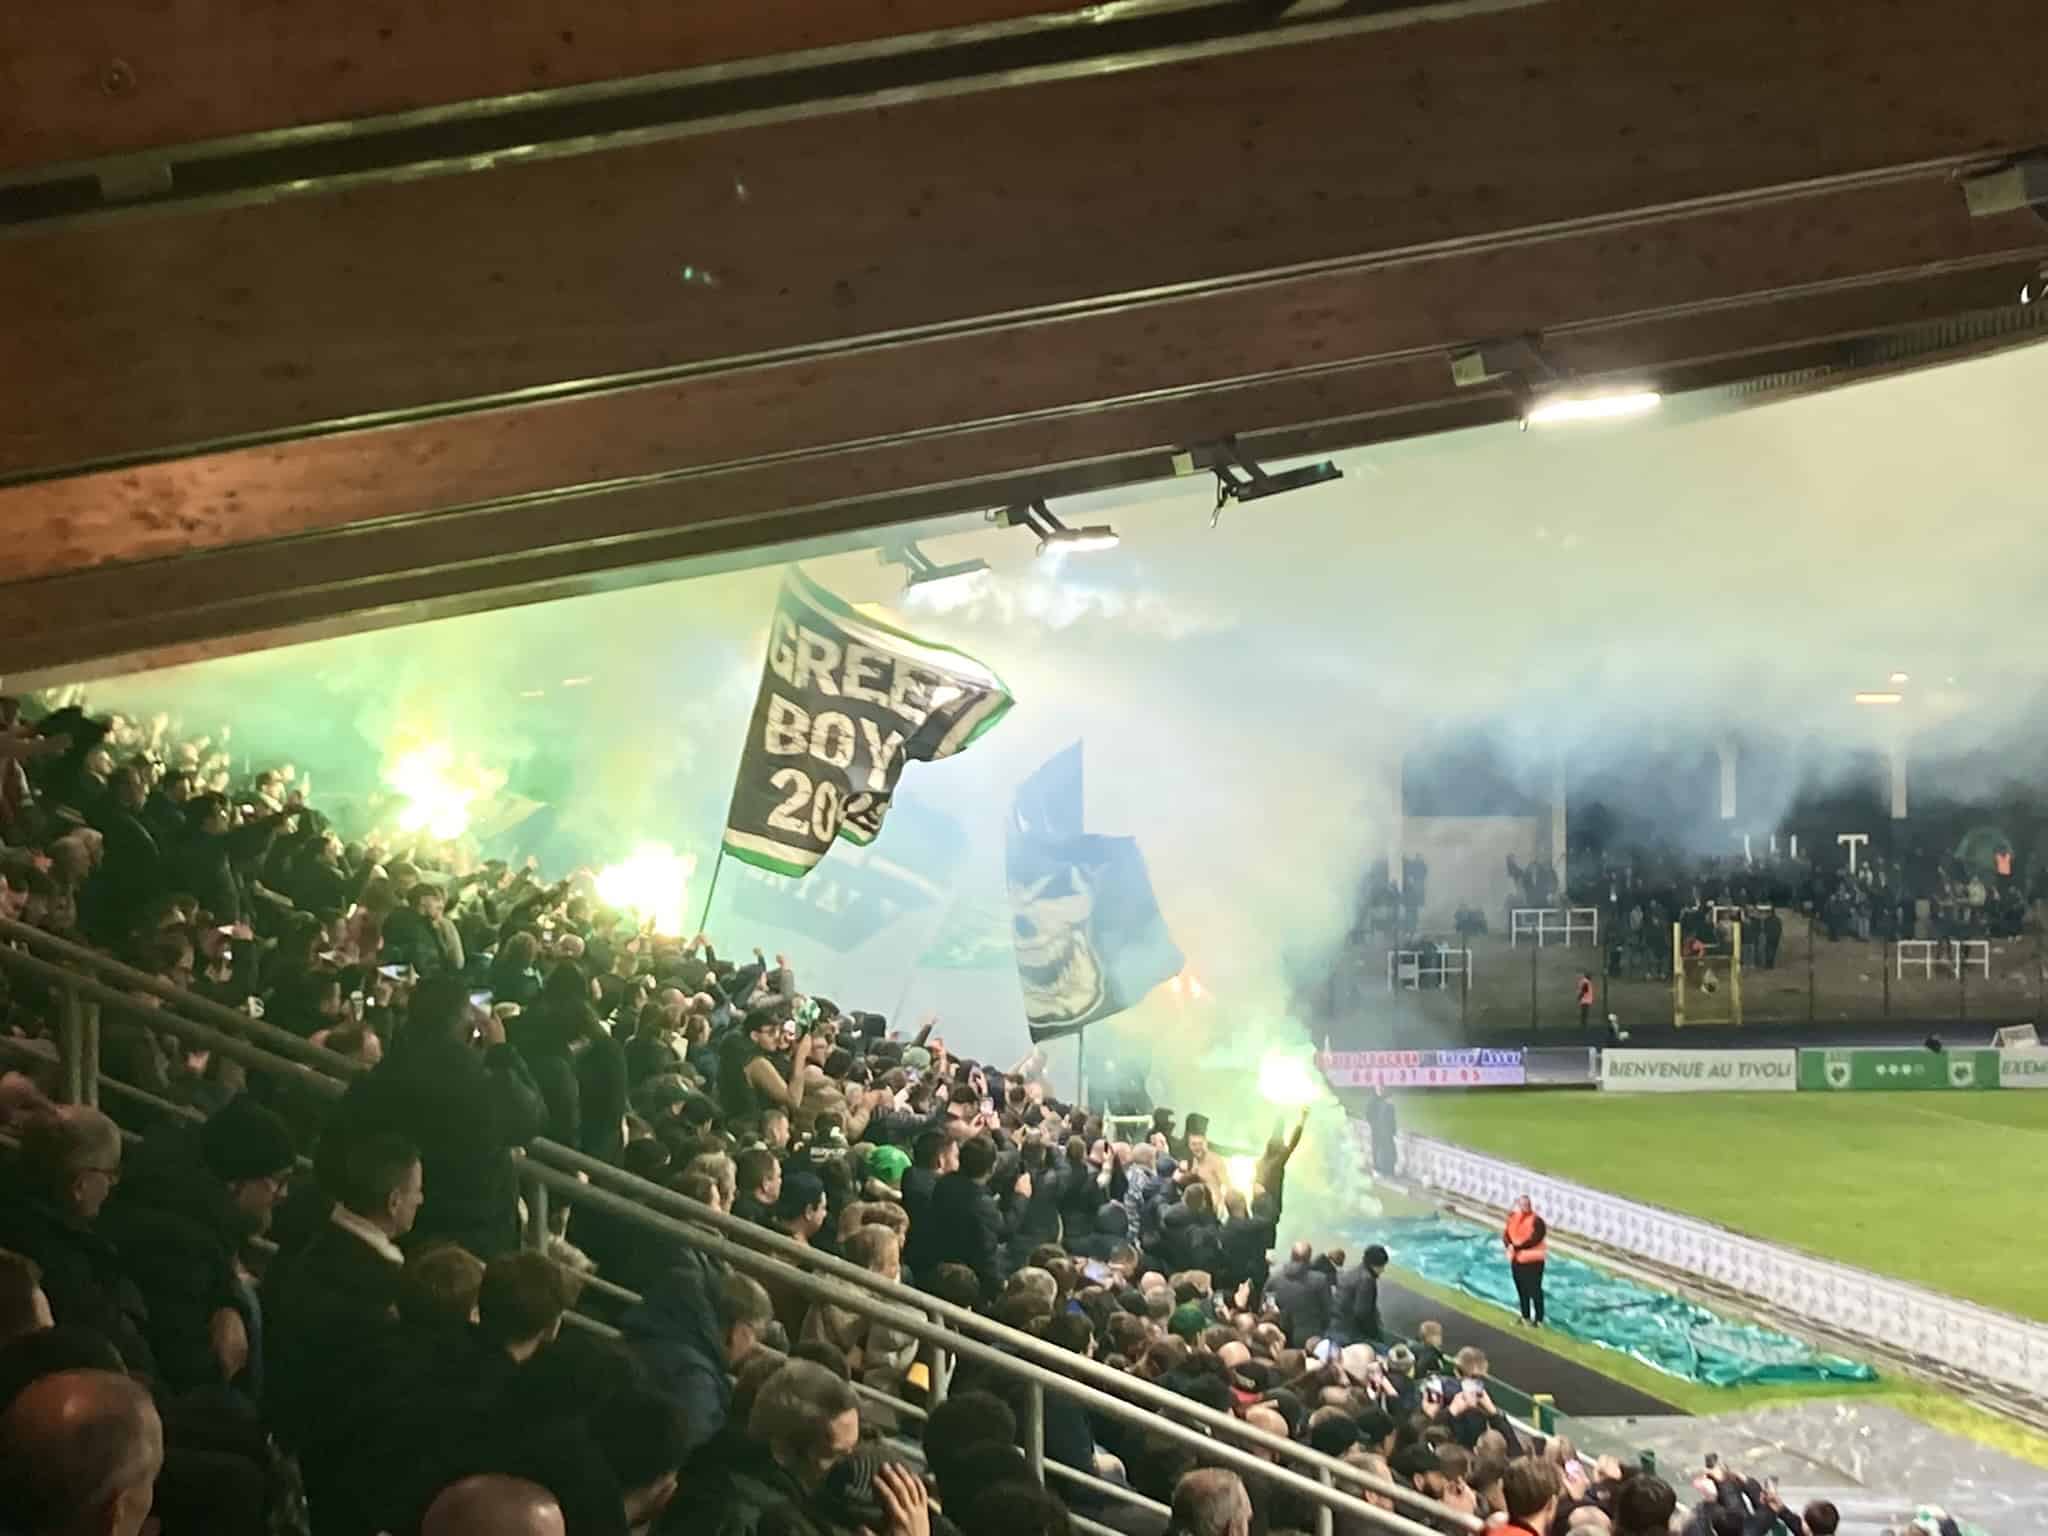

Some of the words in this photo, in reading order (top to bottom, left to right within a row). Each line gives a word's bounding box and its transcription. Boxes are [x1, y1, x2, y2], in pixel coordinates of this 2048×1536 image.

[765, 693, 905, 791] BOY
[1609, 1060, 1704, 1079] BIENVENUE
[1707, 1061, 1733, 1078] AU
[1738, 1060, 1793, 1078] TIVOLI
